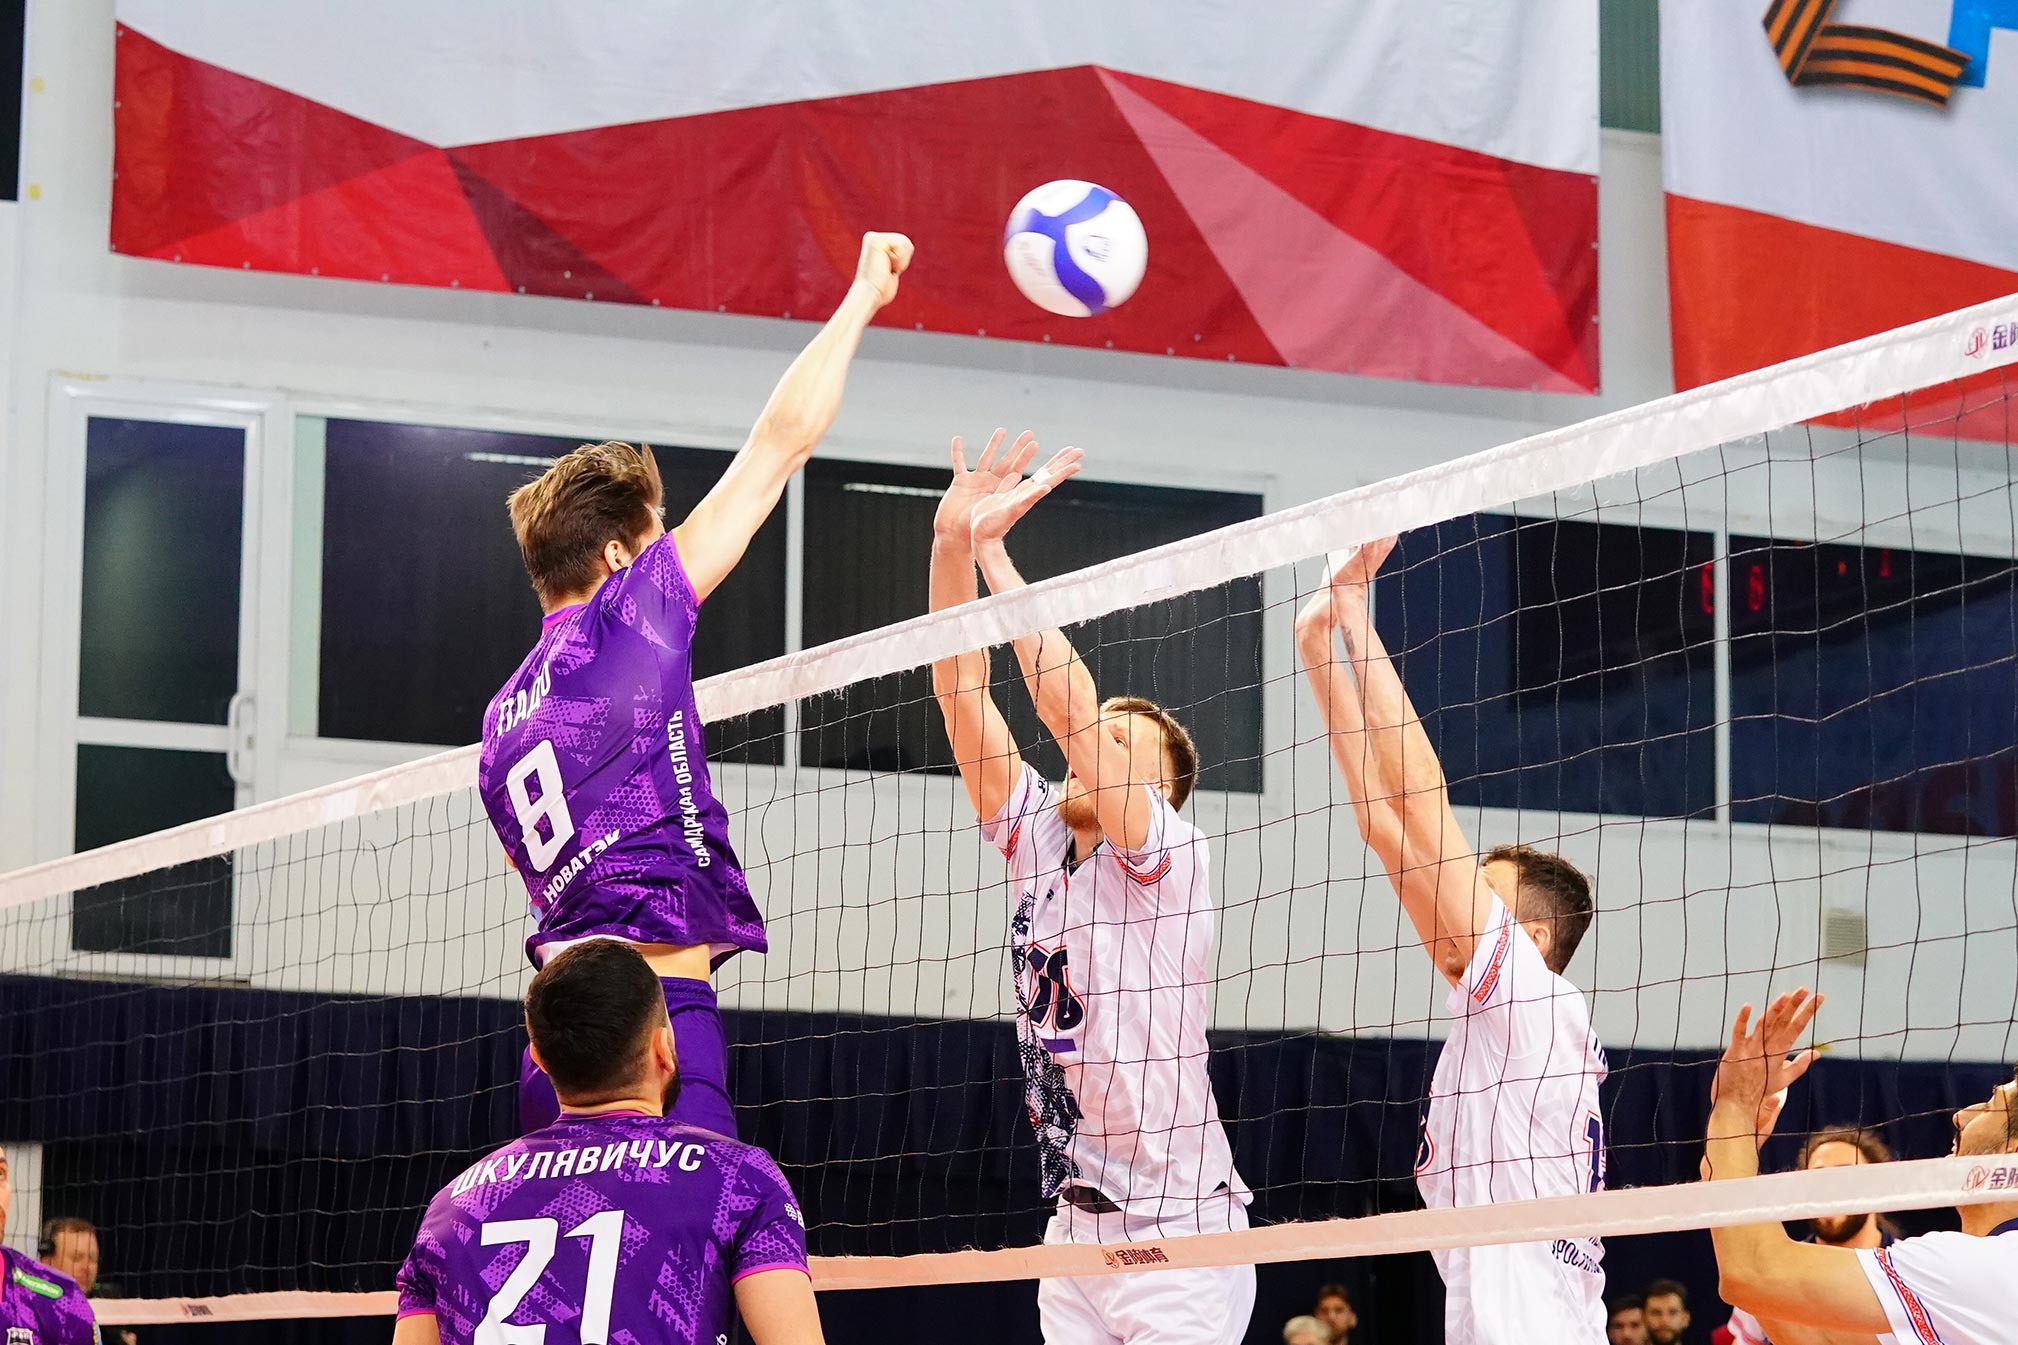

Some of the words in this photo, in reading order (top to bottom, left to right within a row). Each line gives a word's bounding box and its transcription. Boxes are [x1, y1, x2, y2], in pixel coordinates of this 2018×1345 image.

[667, 709, 693, 785] ОБЛАСТЬ
[505, 739, 576, 873] 8
[542, 828, 620, 904] НОВАТЭК
[450, 1139, 706, 1199] ШКУЛЯВИЧУС
[473, 1209, 625, 1345] 21
